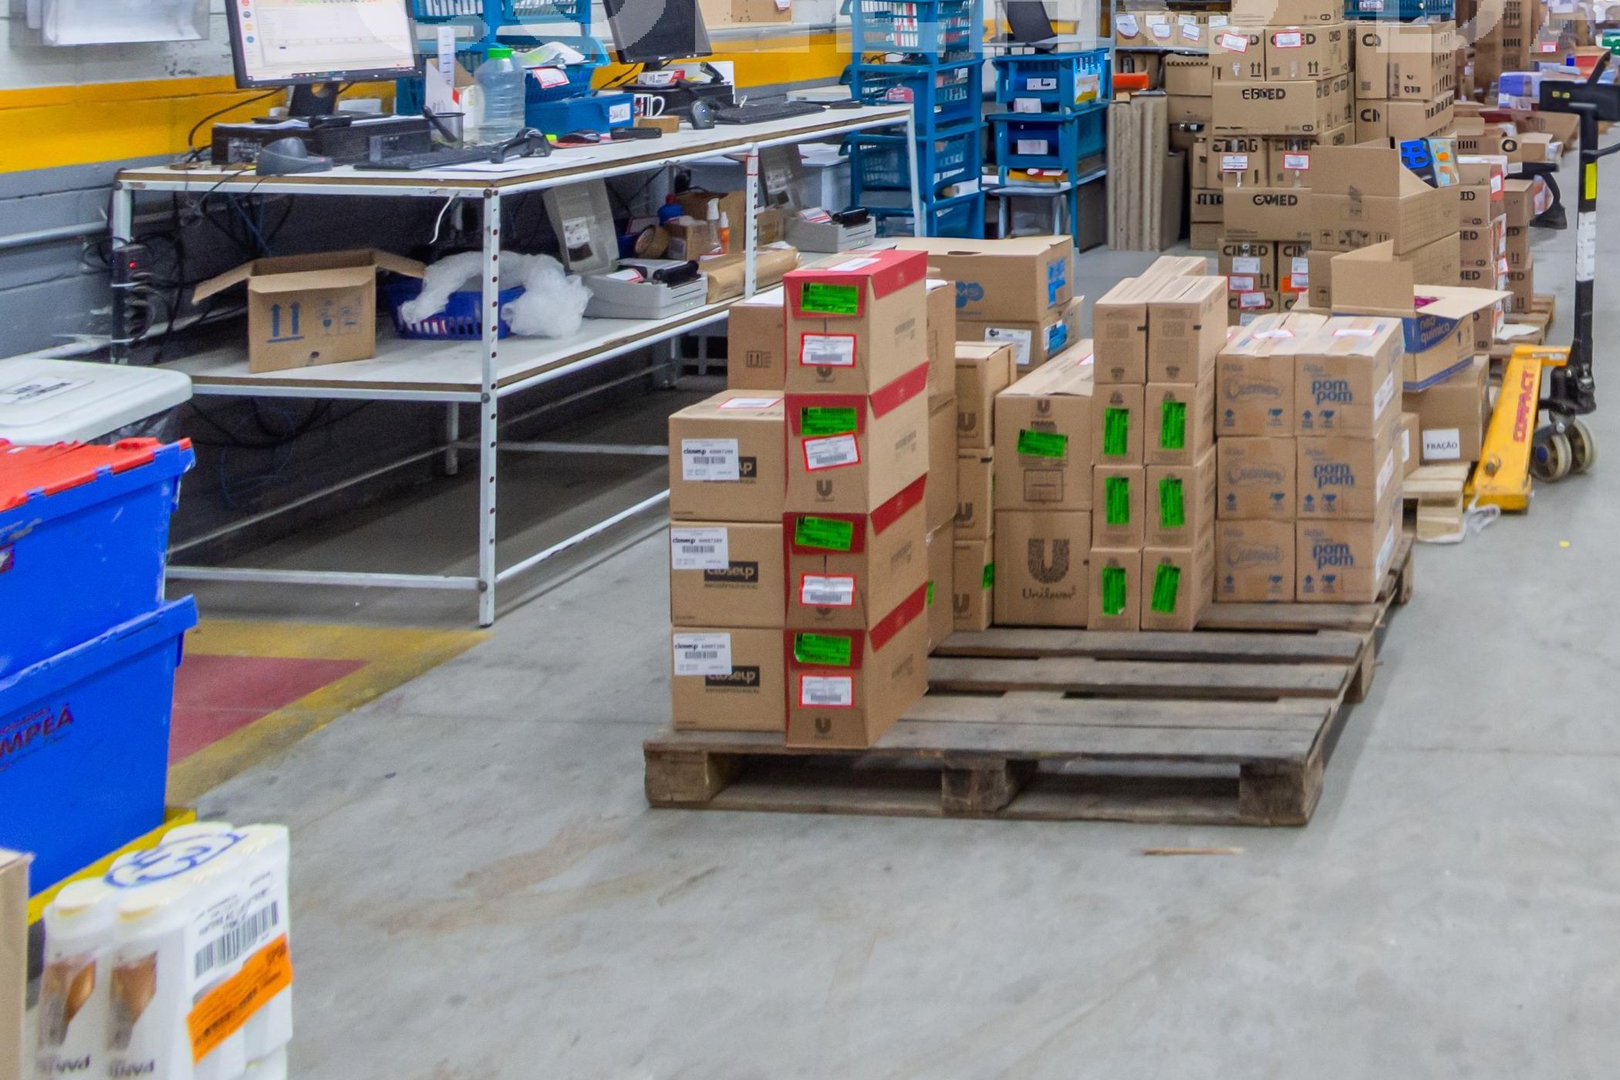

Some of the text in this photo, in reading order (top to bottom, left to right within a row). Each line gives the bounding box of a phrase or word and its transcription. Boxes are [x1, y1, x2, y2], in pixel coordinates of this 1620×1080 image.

[1312, 379, 1348, 395] pom
[1316, 390, 1352, 405] pom
[1426, 440, 1458, 451] FRAÇÃO
[1313, 463, 1350, 478] pom
[1317, 474, 1355, 489] pom
[1313, 543, 1350, 559] pom
[1317, 554, 1354, 570] pom
[1022, 587, 1076, 600] Unilever
